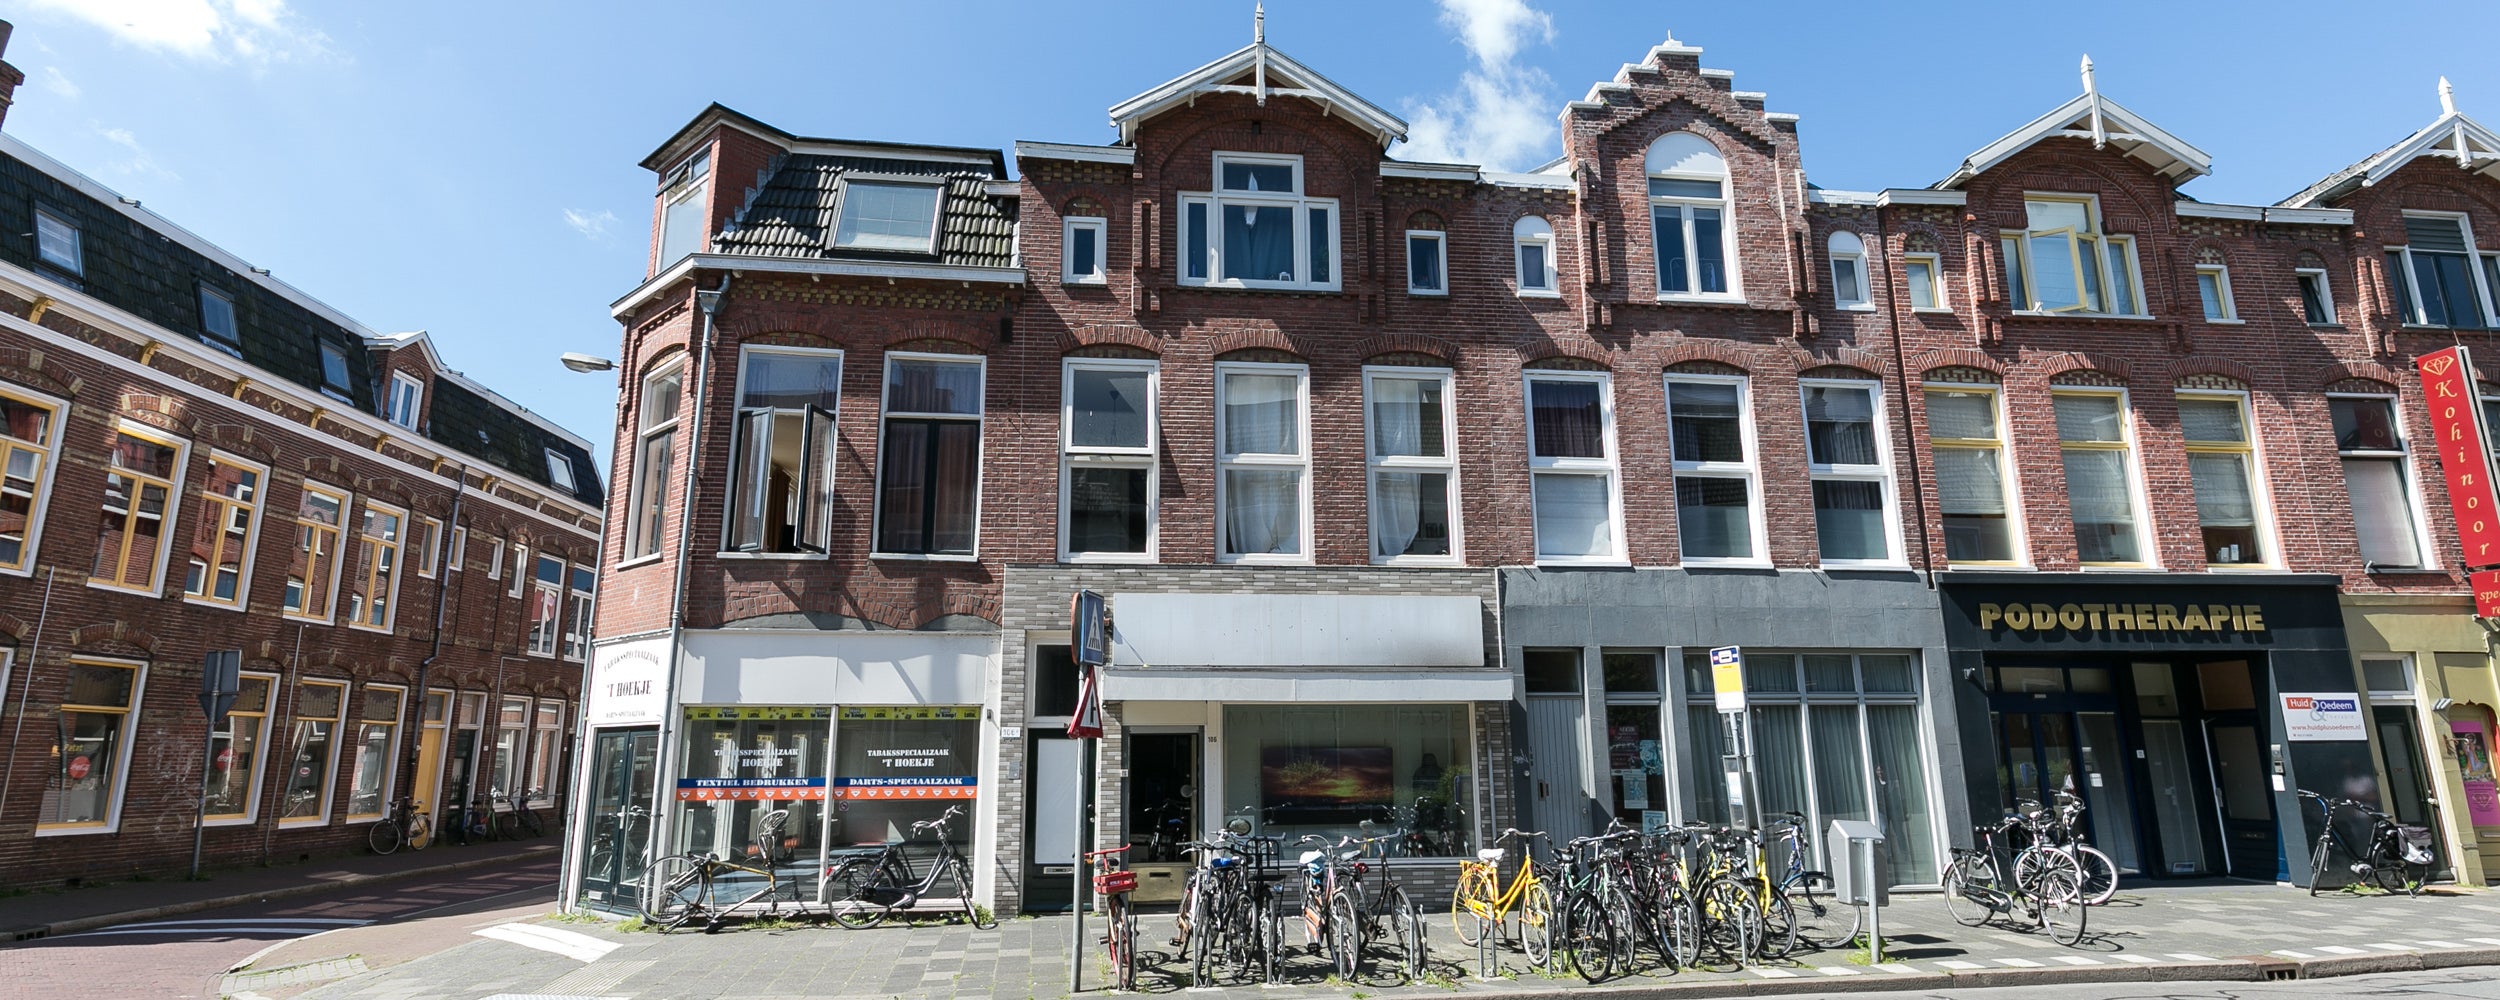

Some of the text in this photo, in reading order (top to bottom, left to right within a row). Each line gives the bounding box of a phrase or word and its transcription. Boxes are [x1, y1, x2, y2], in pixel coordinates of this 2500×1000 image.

[2435, 379, 2490, 556] Kohinoor
[2480, 590, 2500, 604] spe
[1980, 603, 2265, 631] PODOTHERAPIE
[616, 680, 652, 697] HOEKJE
[2290, 698, 2309, 708] Huid
[2320, 701, 2353, 710] Oedeem
[713, 748, 800, 757] TASSPECIALZAAK
[867, 748, 950, 757] TABAKSSPECIAALZAAK
[894, 758, 935, 767] HOEKJE
[696, 779, 809, 787] TEXTIEL BEDRUKKEN
[849, 778, 963, 786] DARTS-SPECIAALZAAK
